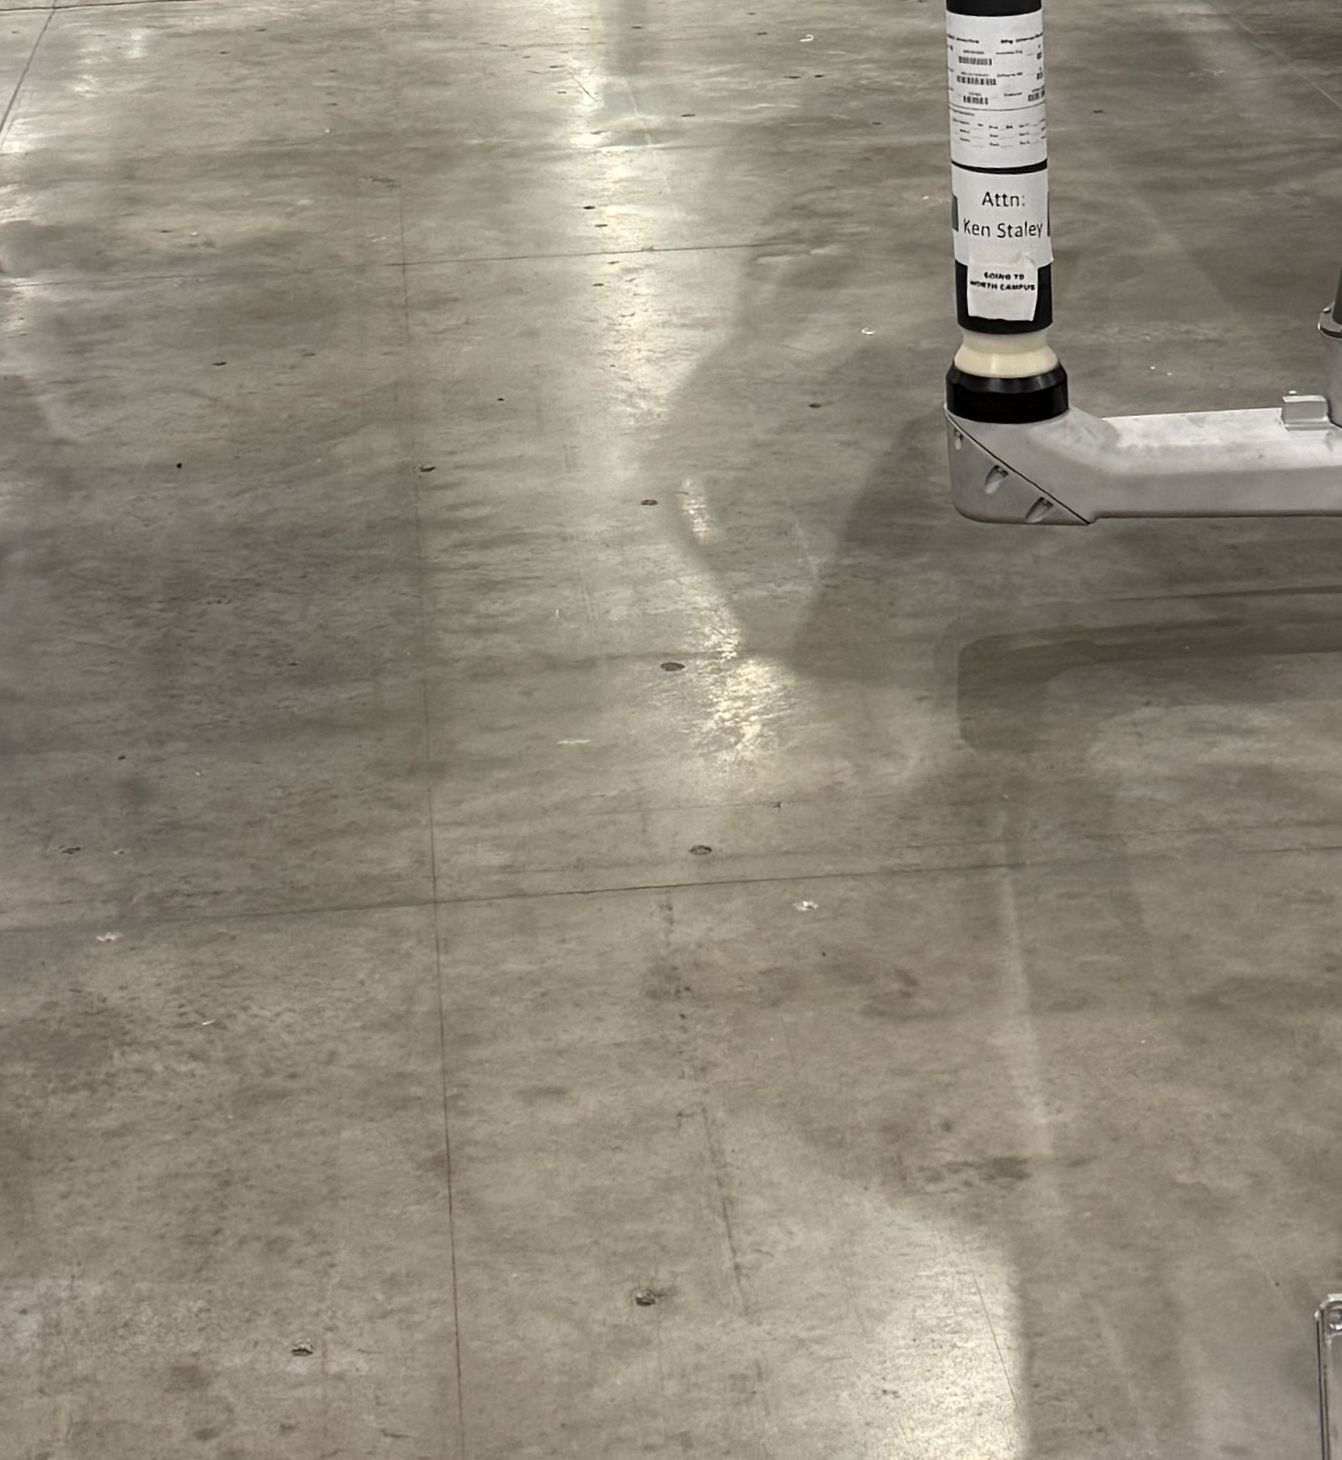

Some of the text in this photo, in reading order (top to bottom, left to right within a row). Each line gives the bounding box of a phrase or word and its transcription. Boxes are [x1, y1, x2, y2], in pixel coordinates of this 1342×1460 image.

[981, 191, 1025, 207] Attn:
[963, 218, 1043, 238] Ken Staley
